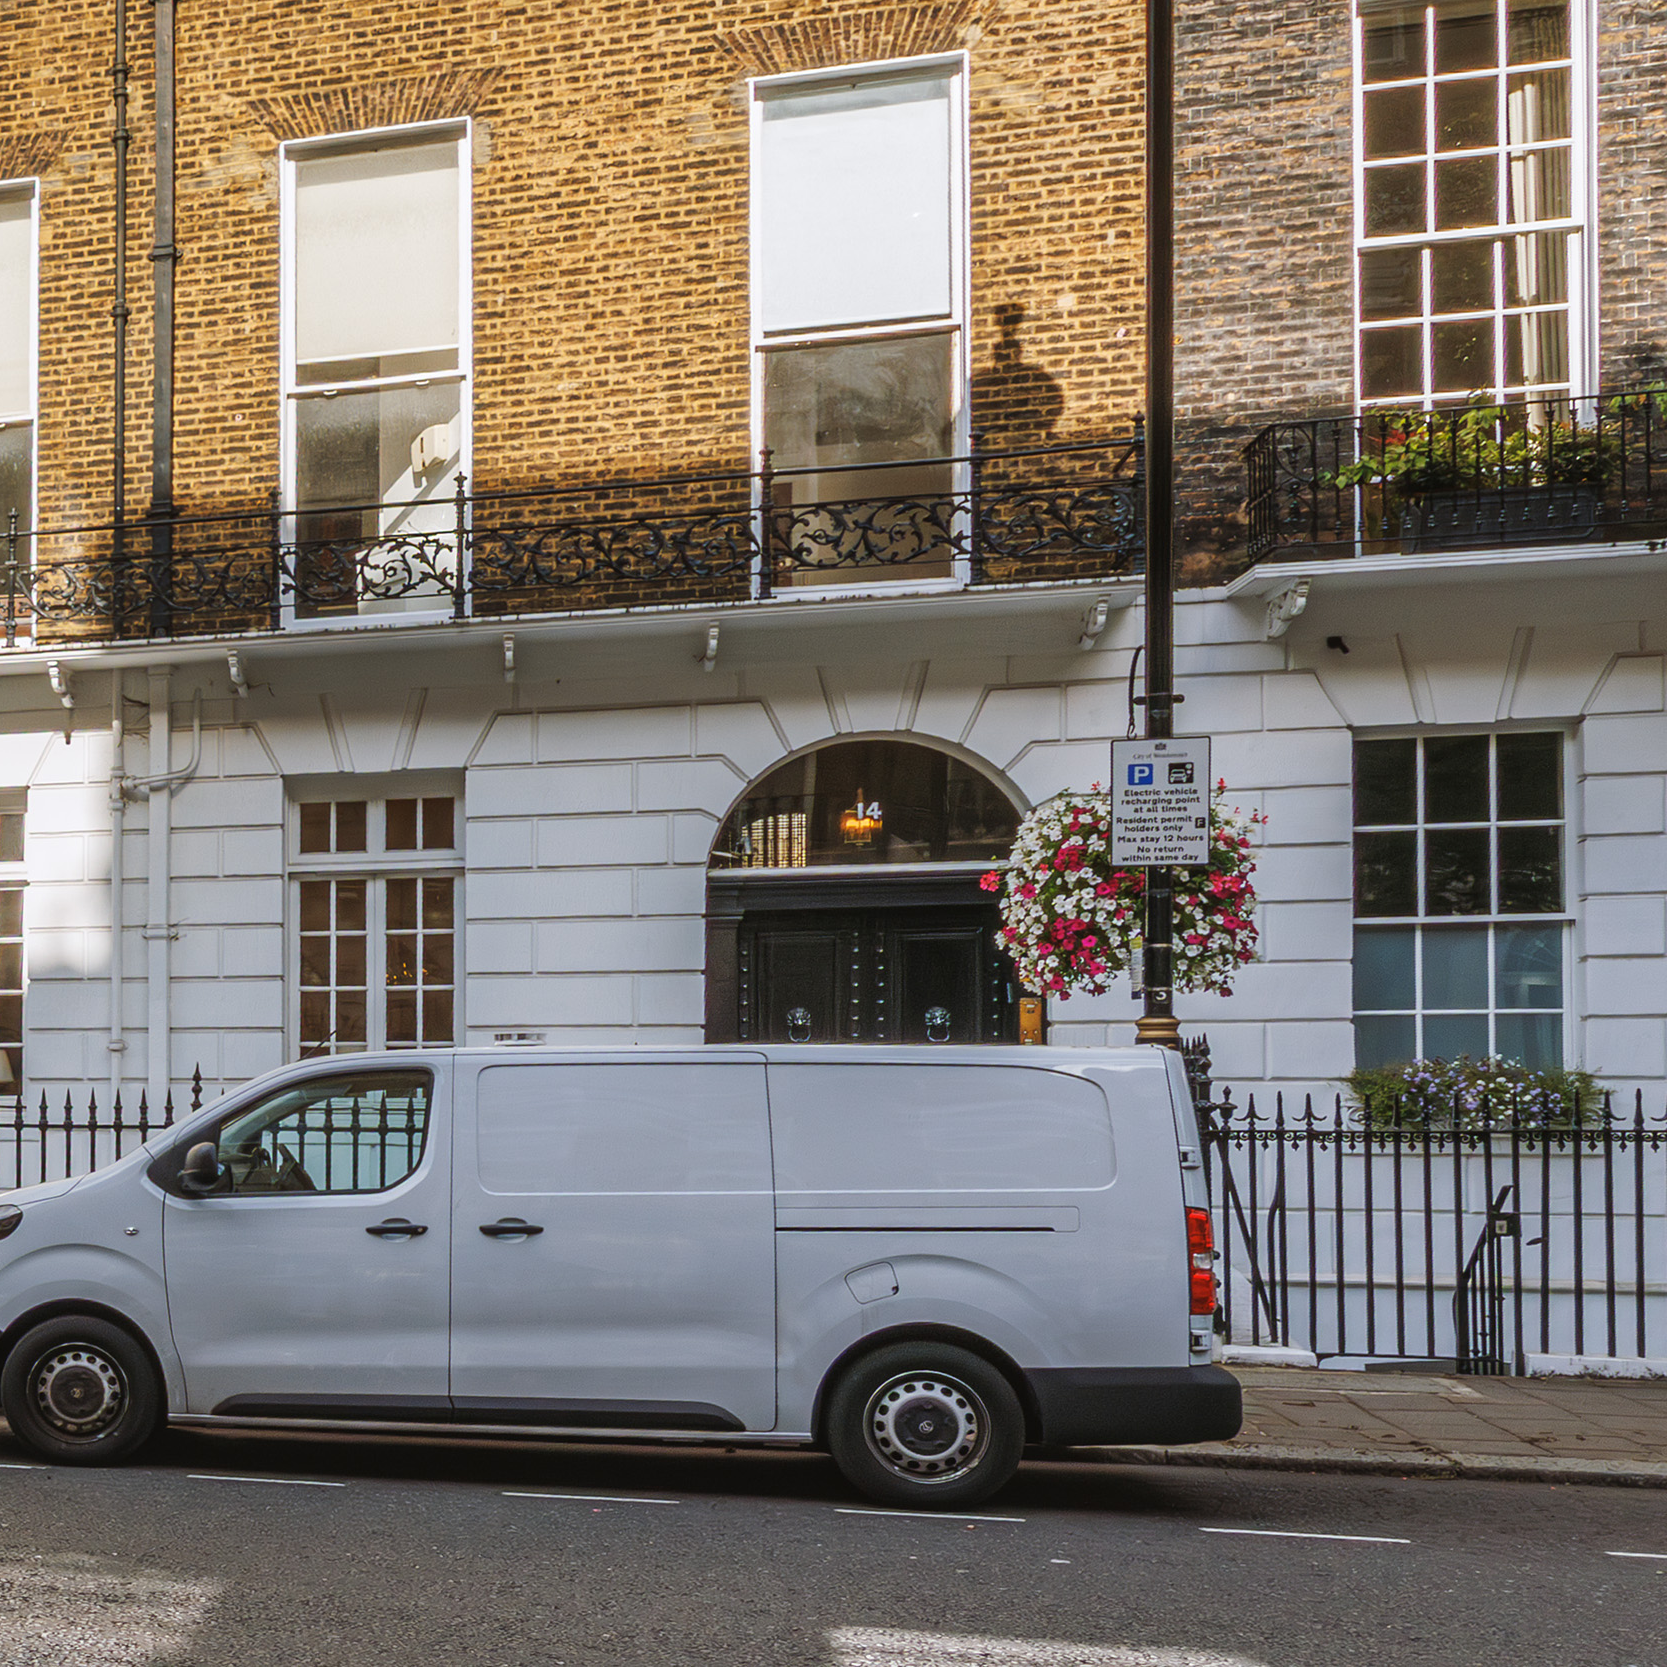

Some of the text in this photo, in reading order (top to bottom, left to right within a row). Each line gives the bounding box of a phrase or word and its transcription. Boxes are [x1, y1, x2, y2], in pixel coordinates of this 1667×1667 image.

[1133, 766, 1150, 784] P
[1124, 787, 1198, 797] Electric vehicle
[1121, 796, 1201, 806] recharging point
[857, 801, 883, 820] 14
[1116, 815, 1193, 824] Resident permit
[1162, 824, 1183, 832] only
[1140, 835, 1160, 844] stay
[1176, 834, 1204, 842] hours
[1181, 853, 1199, 861] day
